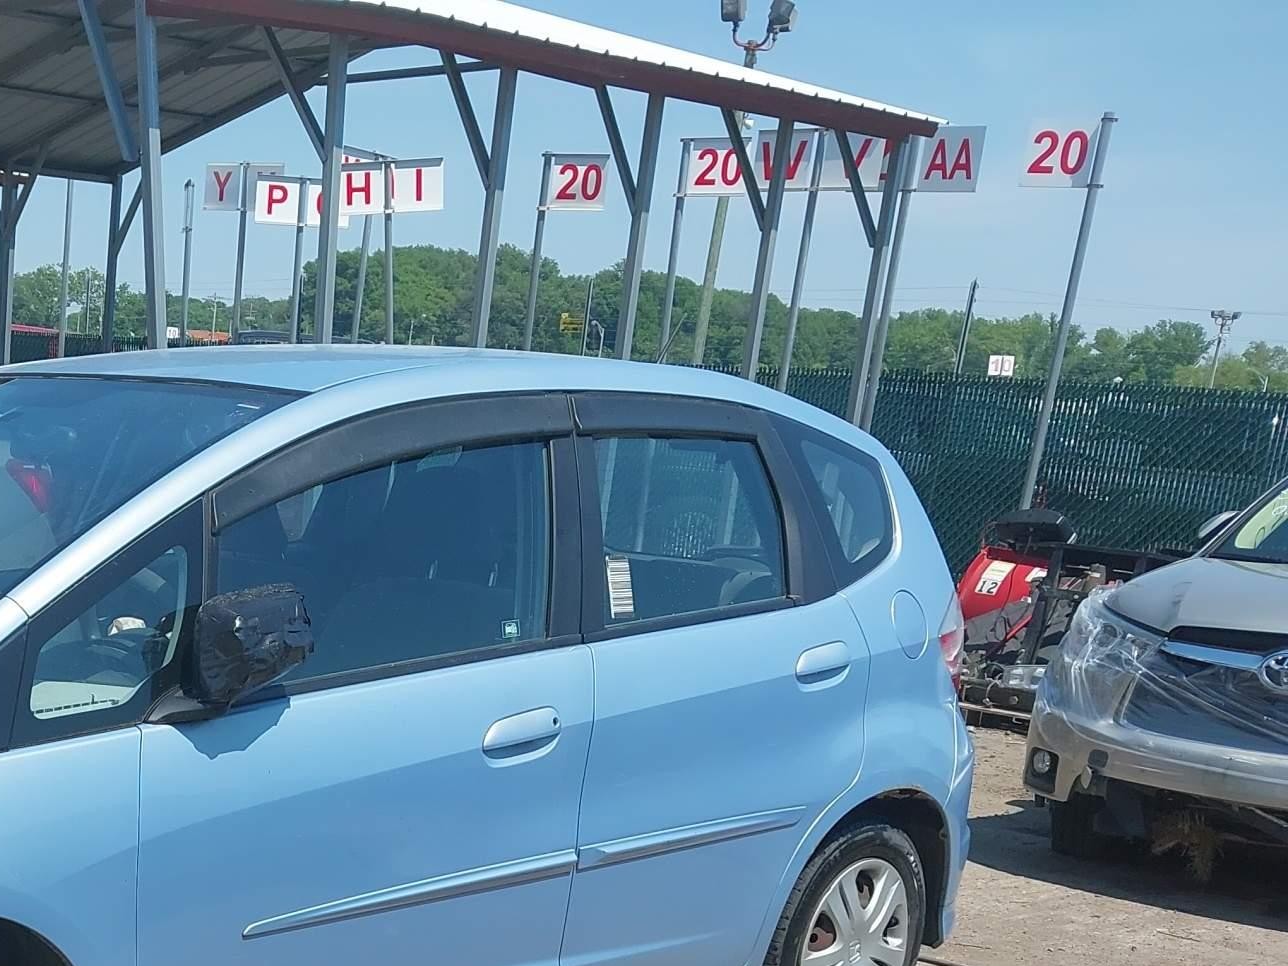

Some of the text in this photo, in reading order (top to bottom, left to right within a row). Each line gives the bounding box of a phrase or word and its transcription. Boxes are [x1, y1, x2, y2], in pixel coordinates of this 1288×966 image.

[694, 148, 742, 186] 20
[924, 138, 972, 180] AA
[1027, 130, 1089, 175] 20
[213, 171, 233, 202] Y
[346, 172, 371, 206] H
[415, 168, 423, 202] I
[556, 163, 602, 200] 20
[267, 184, 289, 215] P
[992, 358, 1012, 372] 10
[978, 580, 999, 594] 12
